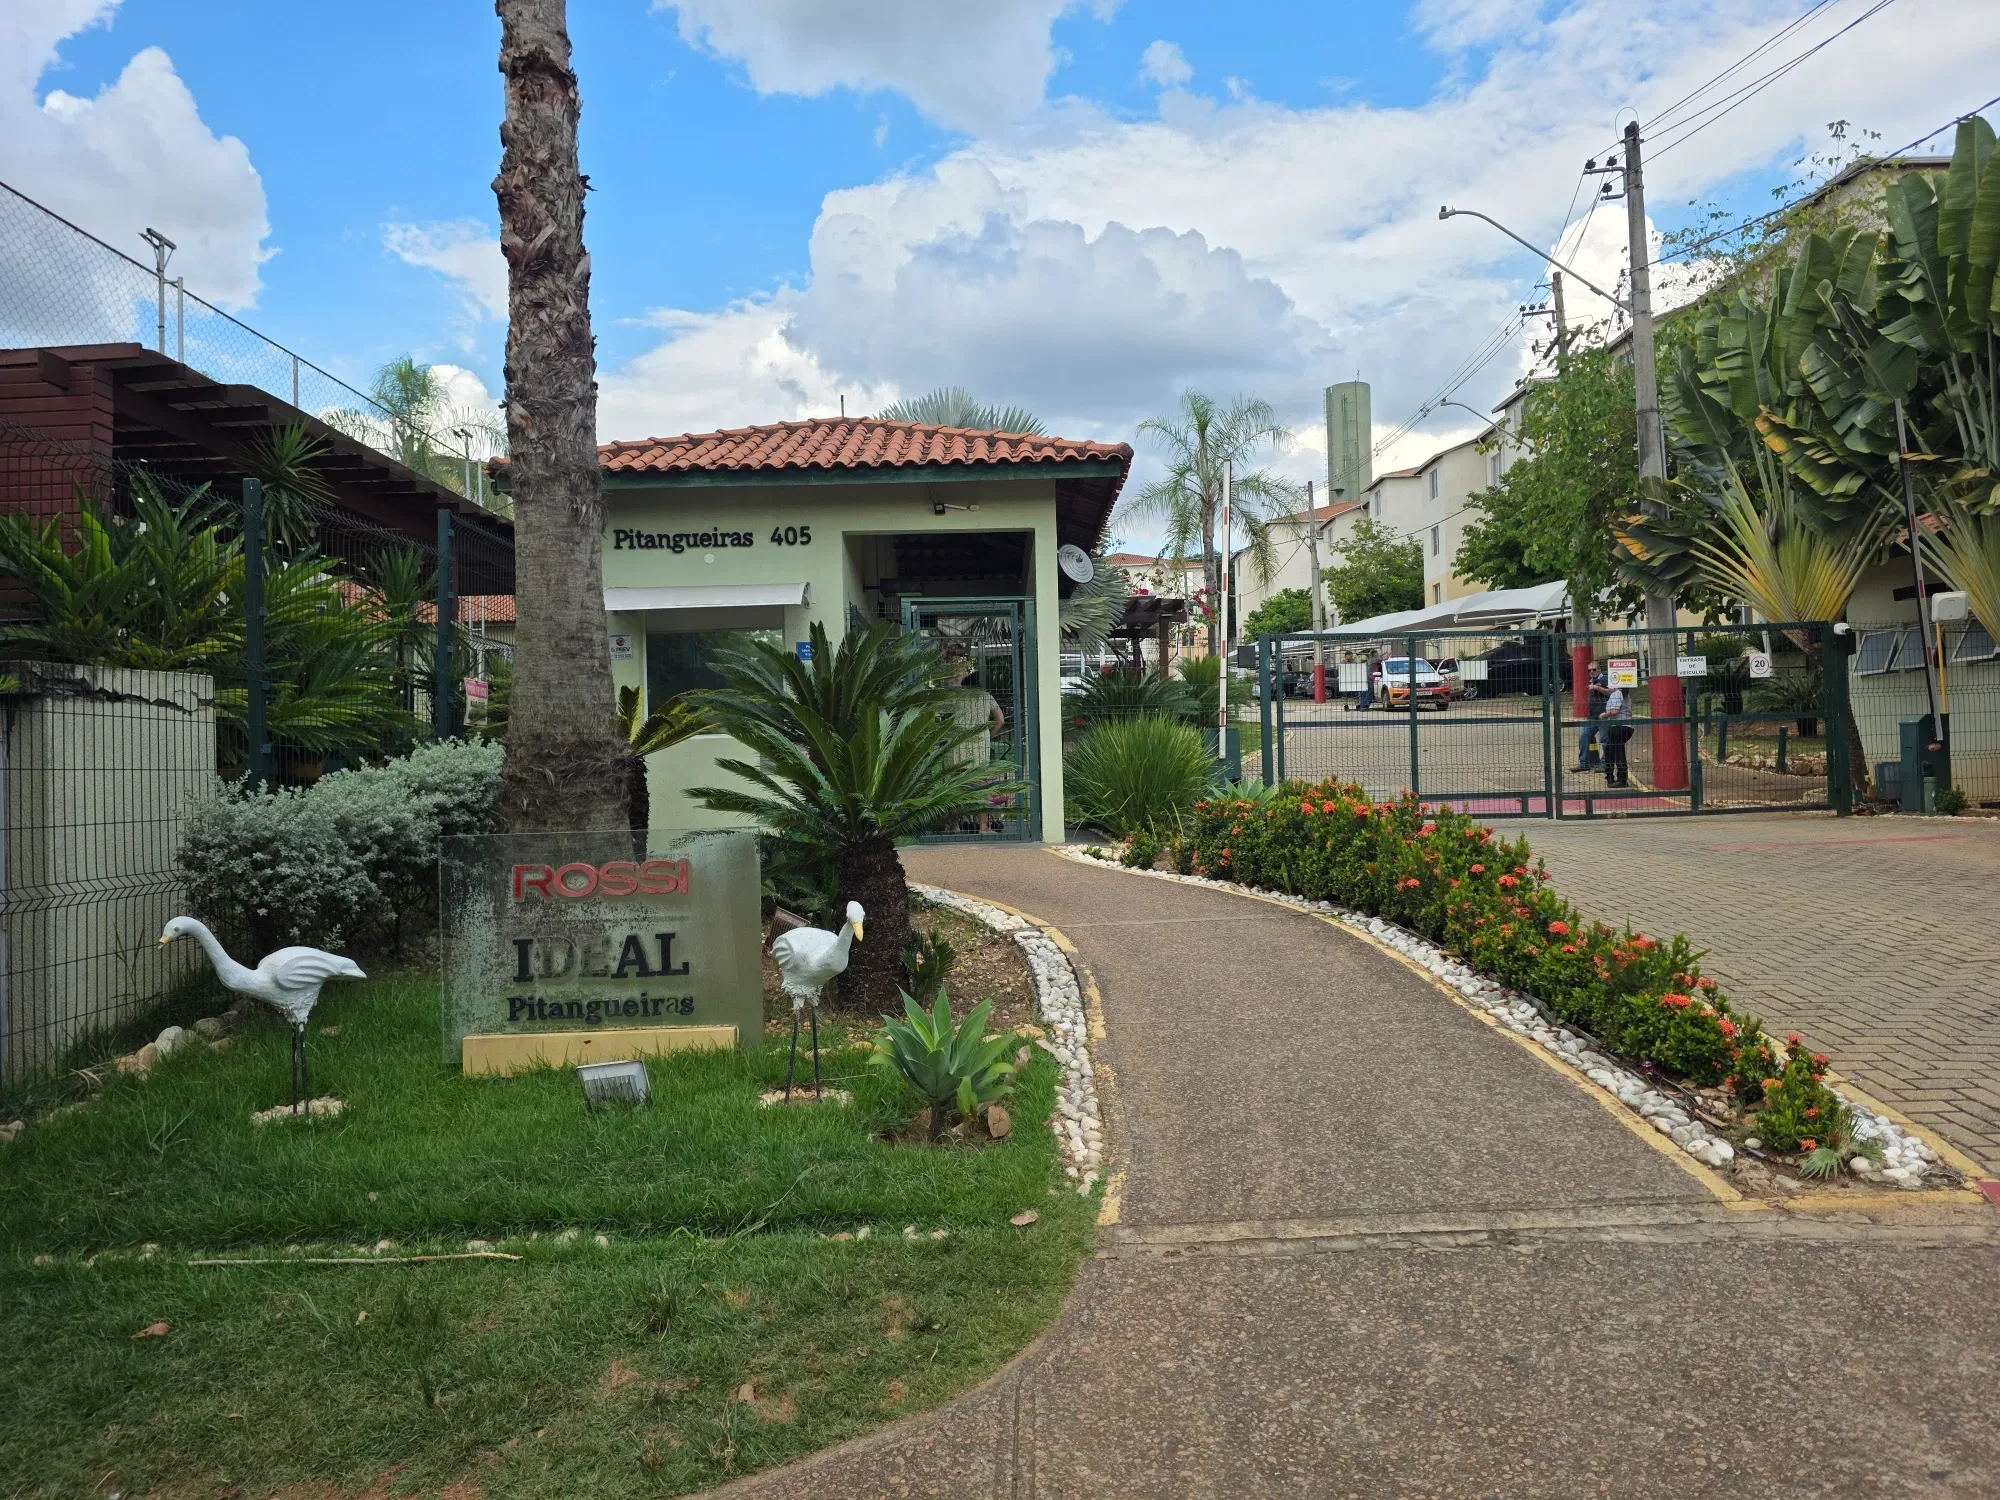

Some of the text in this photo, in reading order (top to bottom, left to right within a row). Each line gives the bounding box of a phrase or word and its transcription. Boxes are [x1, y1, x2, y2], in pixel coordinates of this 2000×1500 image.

[613, 525, 812, 554] Pitangueiras 405
[1754, 660, 1766, 668] 20
[512, 858, 690, 900] ROSSI
[512, 932, 690, 983] IDEAL
[506, 992, 695, 1024] Pitangueiras
